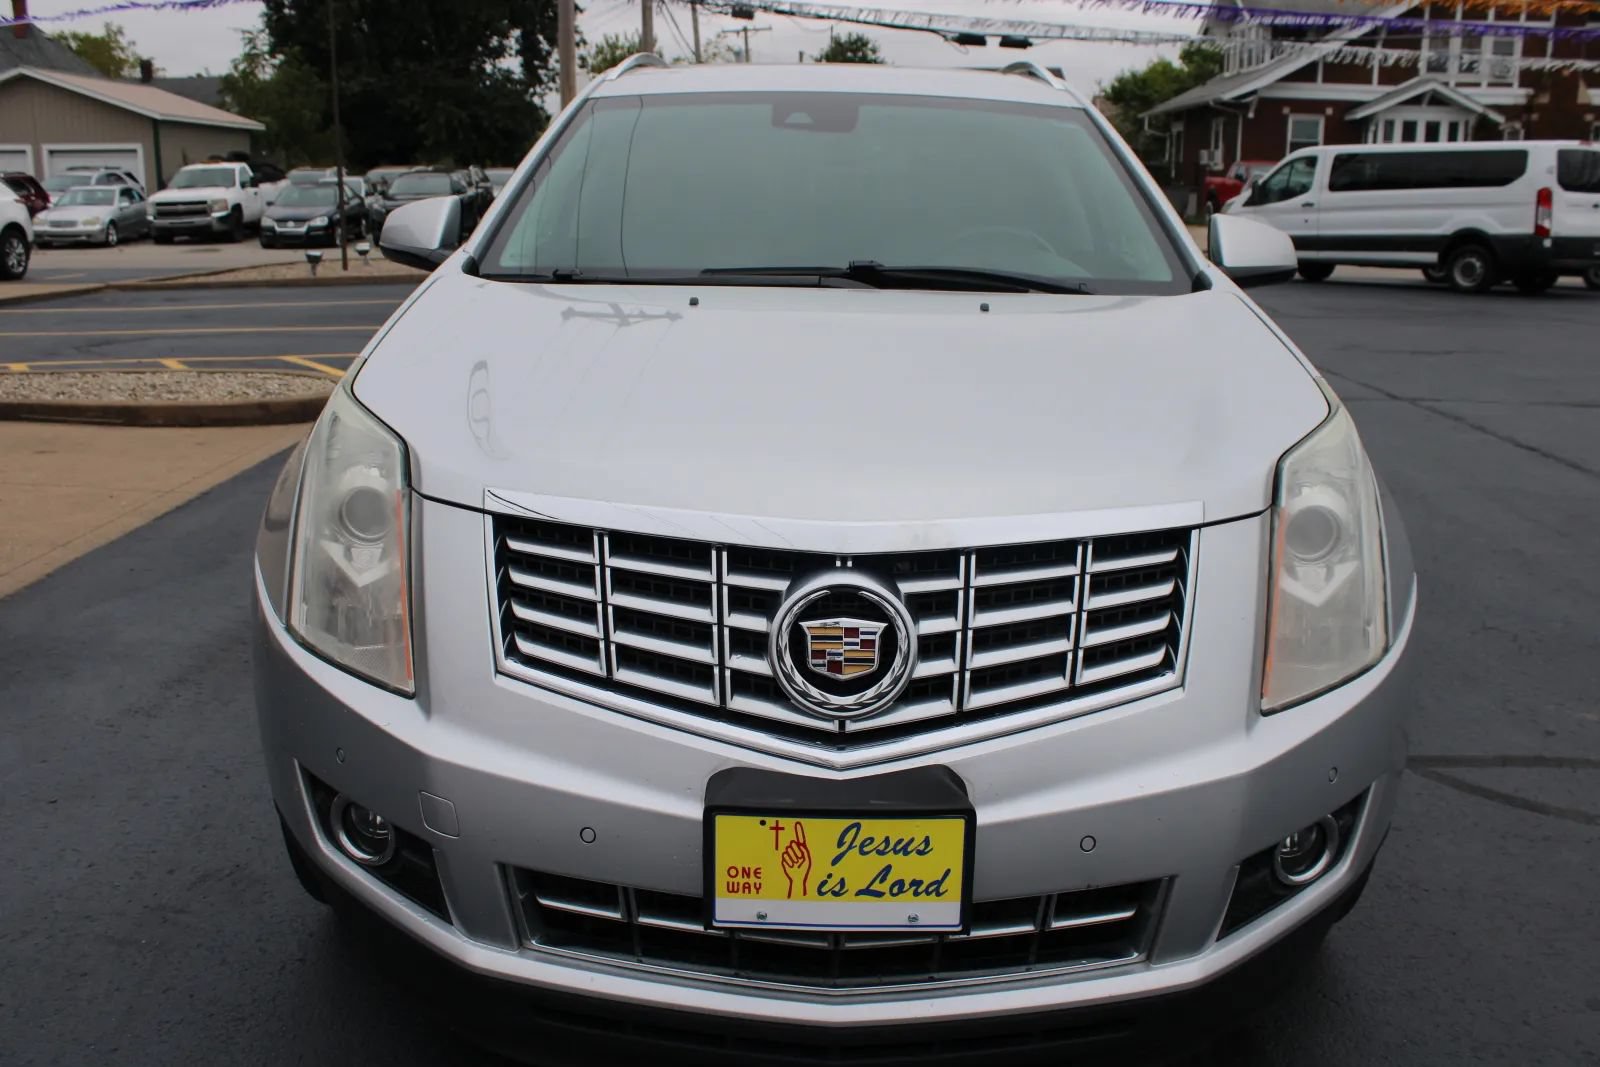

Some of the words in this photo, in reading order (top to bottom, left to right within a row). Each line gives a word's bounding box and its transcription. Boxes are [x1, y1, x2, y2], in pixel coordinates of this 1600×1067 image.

[831, 822, 934, 866] Jesus
[727, 866, 762, 879] ONE
[816, 873, 849, 897] is
[854, 864, 951, 898] Lord
[727, 881, 762, 895] WAY
